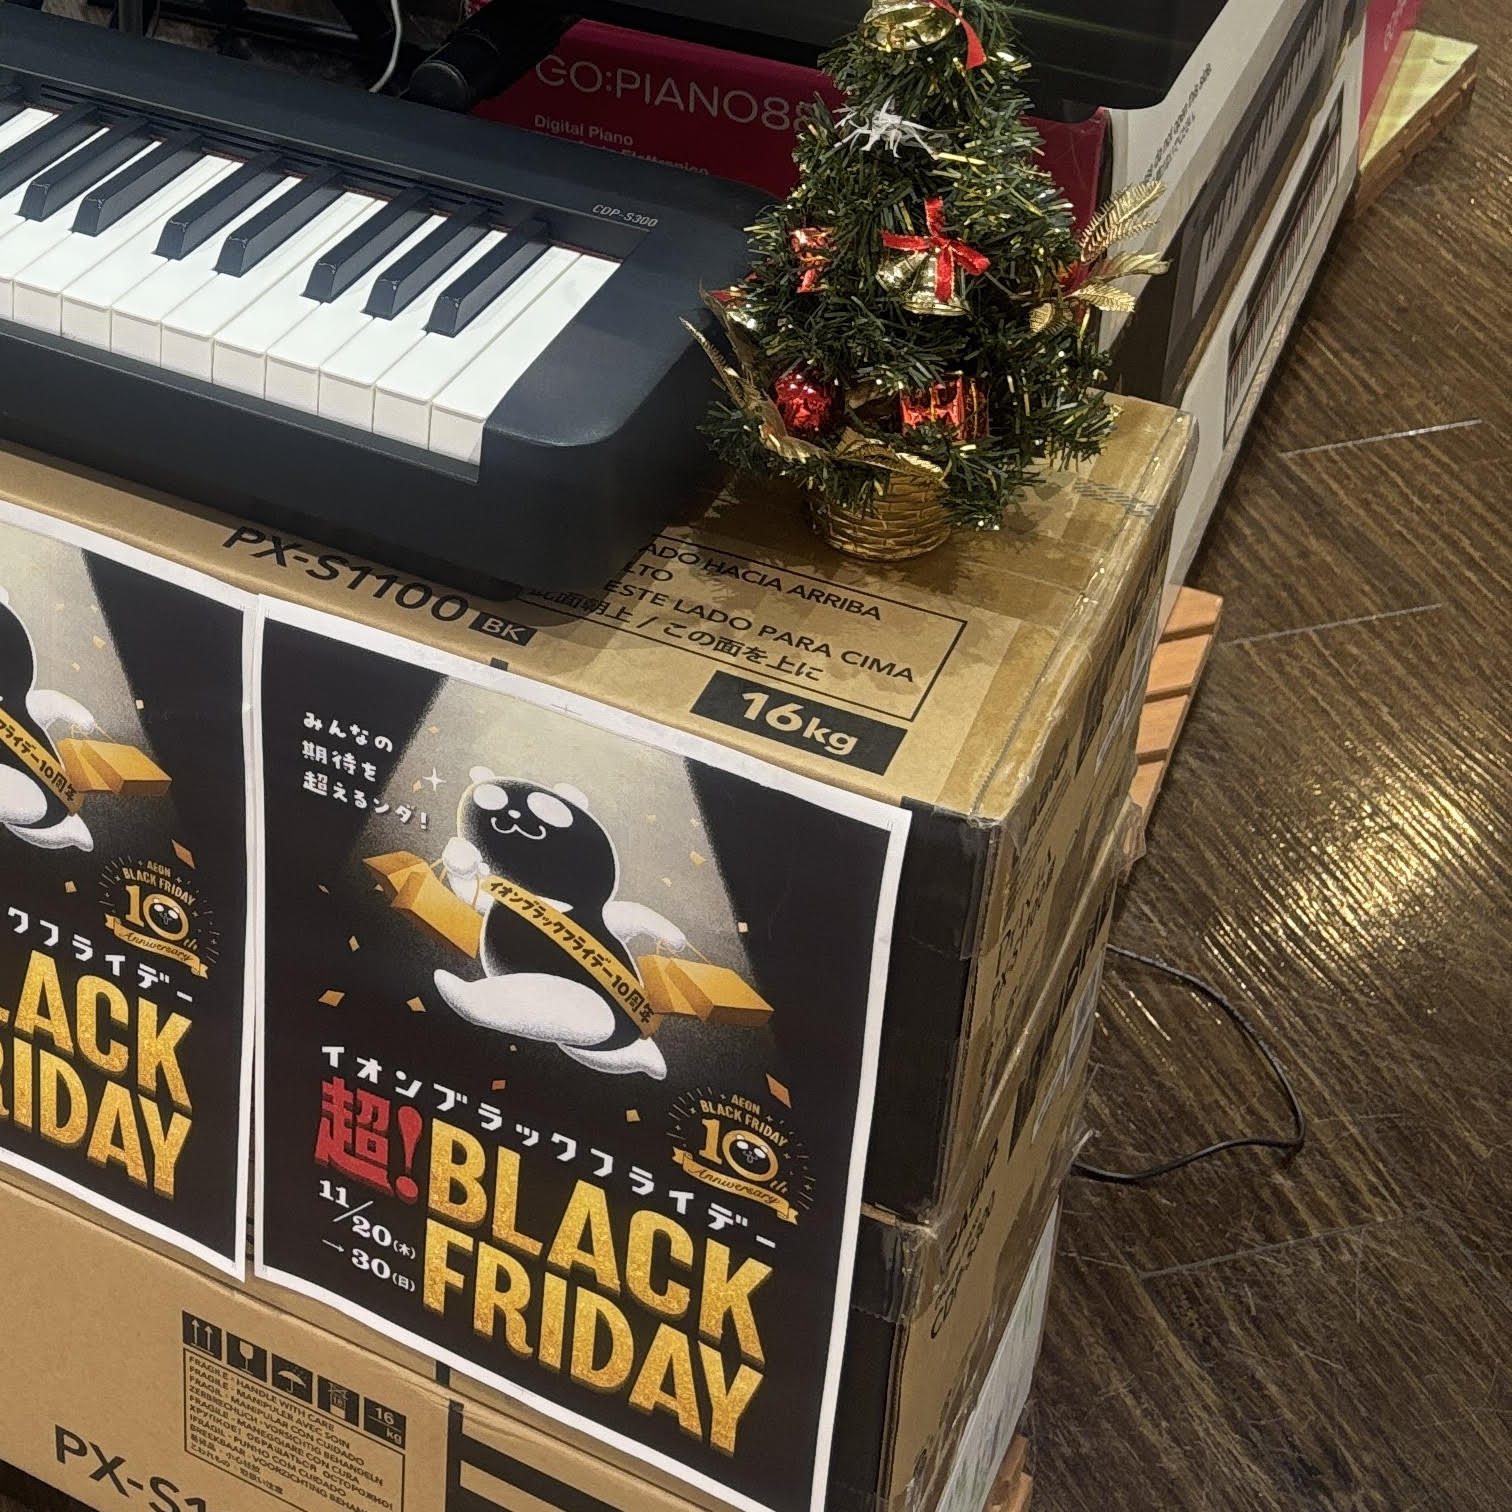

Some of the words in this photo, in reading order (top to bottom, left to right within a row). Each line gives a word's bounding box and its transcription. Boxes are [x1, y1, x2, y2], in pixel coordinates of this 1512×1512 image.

[534, 114, 585, 137] Digital
[588, 125, 634, 146] Piano
[592, 203, 659, 228] CDP-S300
[222, 525, 473, 622] PX-S1100
[480, 617, 527, 643] BK
[623, 561, 674, 583] LTO
[639, 541, 702, 567] ADO
[703, 559, 785, 592] HACIA
[789, 583, 881, 621] ARRIBA
[604, 578, 668, 606] ESTE
[673, 597, 753, 632] LADO
[759, 623, 832, 659] PARA
[840, 650, 915, 684] CIMA
[662, 621, 825, 683] この面を上に
[302, 711, 394, 753] みんなの
[740, 691, 860, 757] 16kg
[301, 739, 378, 784] 期待を
[121, 867, 158, 887] BLACK
[158, 877, 197, 907] FRIDAY
[146, 859, 171, 878] AEON
[119, 931, 195, 962] Anniversary
[488, 880, 658, 1026] イオンブラックフライデー10周年
[699, 1099, 743, 1123] BLACK
[744, 1112, 789, 1147] FRIDAY
[730, 1094, 761, 1115] AEON
[321, 1045, 777, 1250] イオンブラックフライデー
[691, 1168, 781, 1205] Anniversary
[426, 1116, 774, 1368] BLACK
[422, 1217, 765, 1460] FRIDAY
[189, 1355, 229, 1380] FRAGILE
[236, 1378, 277, 1405] HANDLE
[279, 1399, 307, 1419] WITH
[307, 1413, 335, 1432] CARE
[189, 1366, 229, 1391] FRAGILE
[236, 1388, 294, 1422] MANIPULER
[295, 1418, 323, 1436] AVEC
[324, 1430, 350, 1450] SOIN
[189, 1375, 223, 1399] FRAGIL
[230, 1395, 289, 1429] MANIPULAR
[290, 1425, 314, 1442] CON
[315, 1436, 365, 1467] CUIDADO
[374, 1407, 395, 1426] 16
[189, 1395, 229, 1420] FRAGILE
[306, 1451, 330, 1469] CON
[331, 1463, 360, 1485] CURA
[386, 1427, 402, 1445] kg
